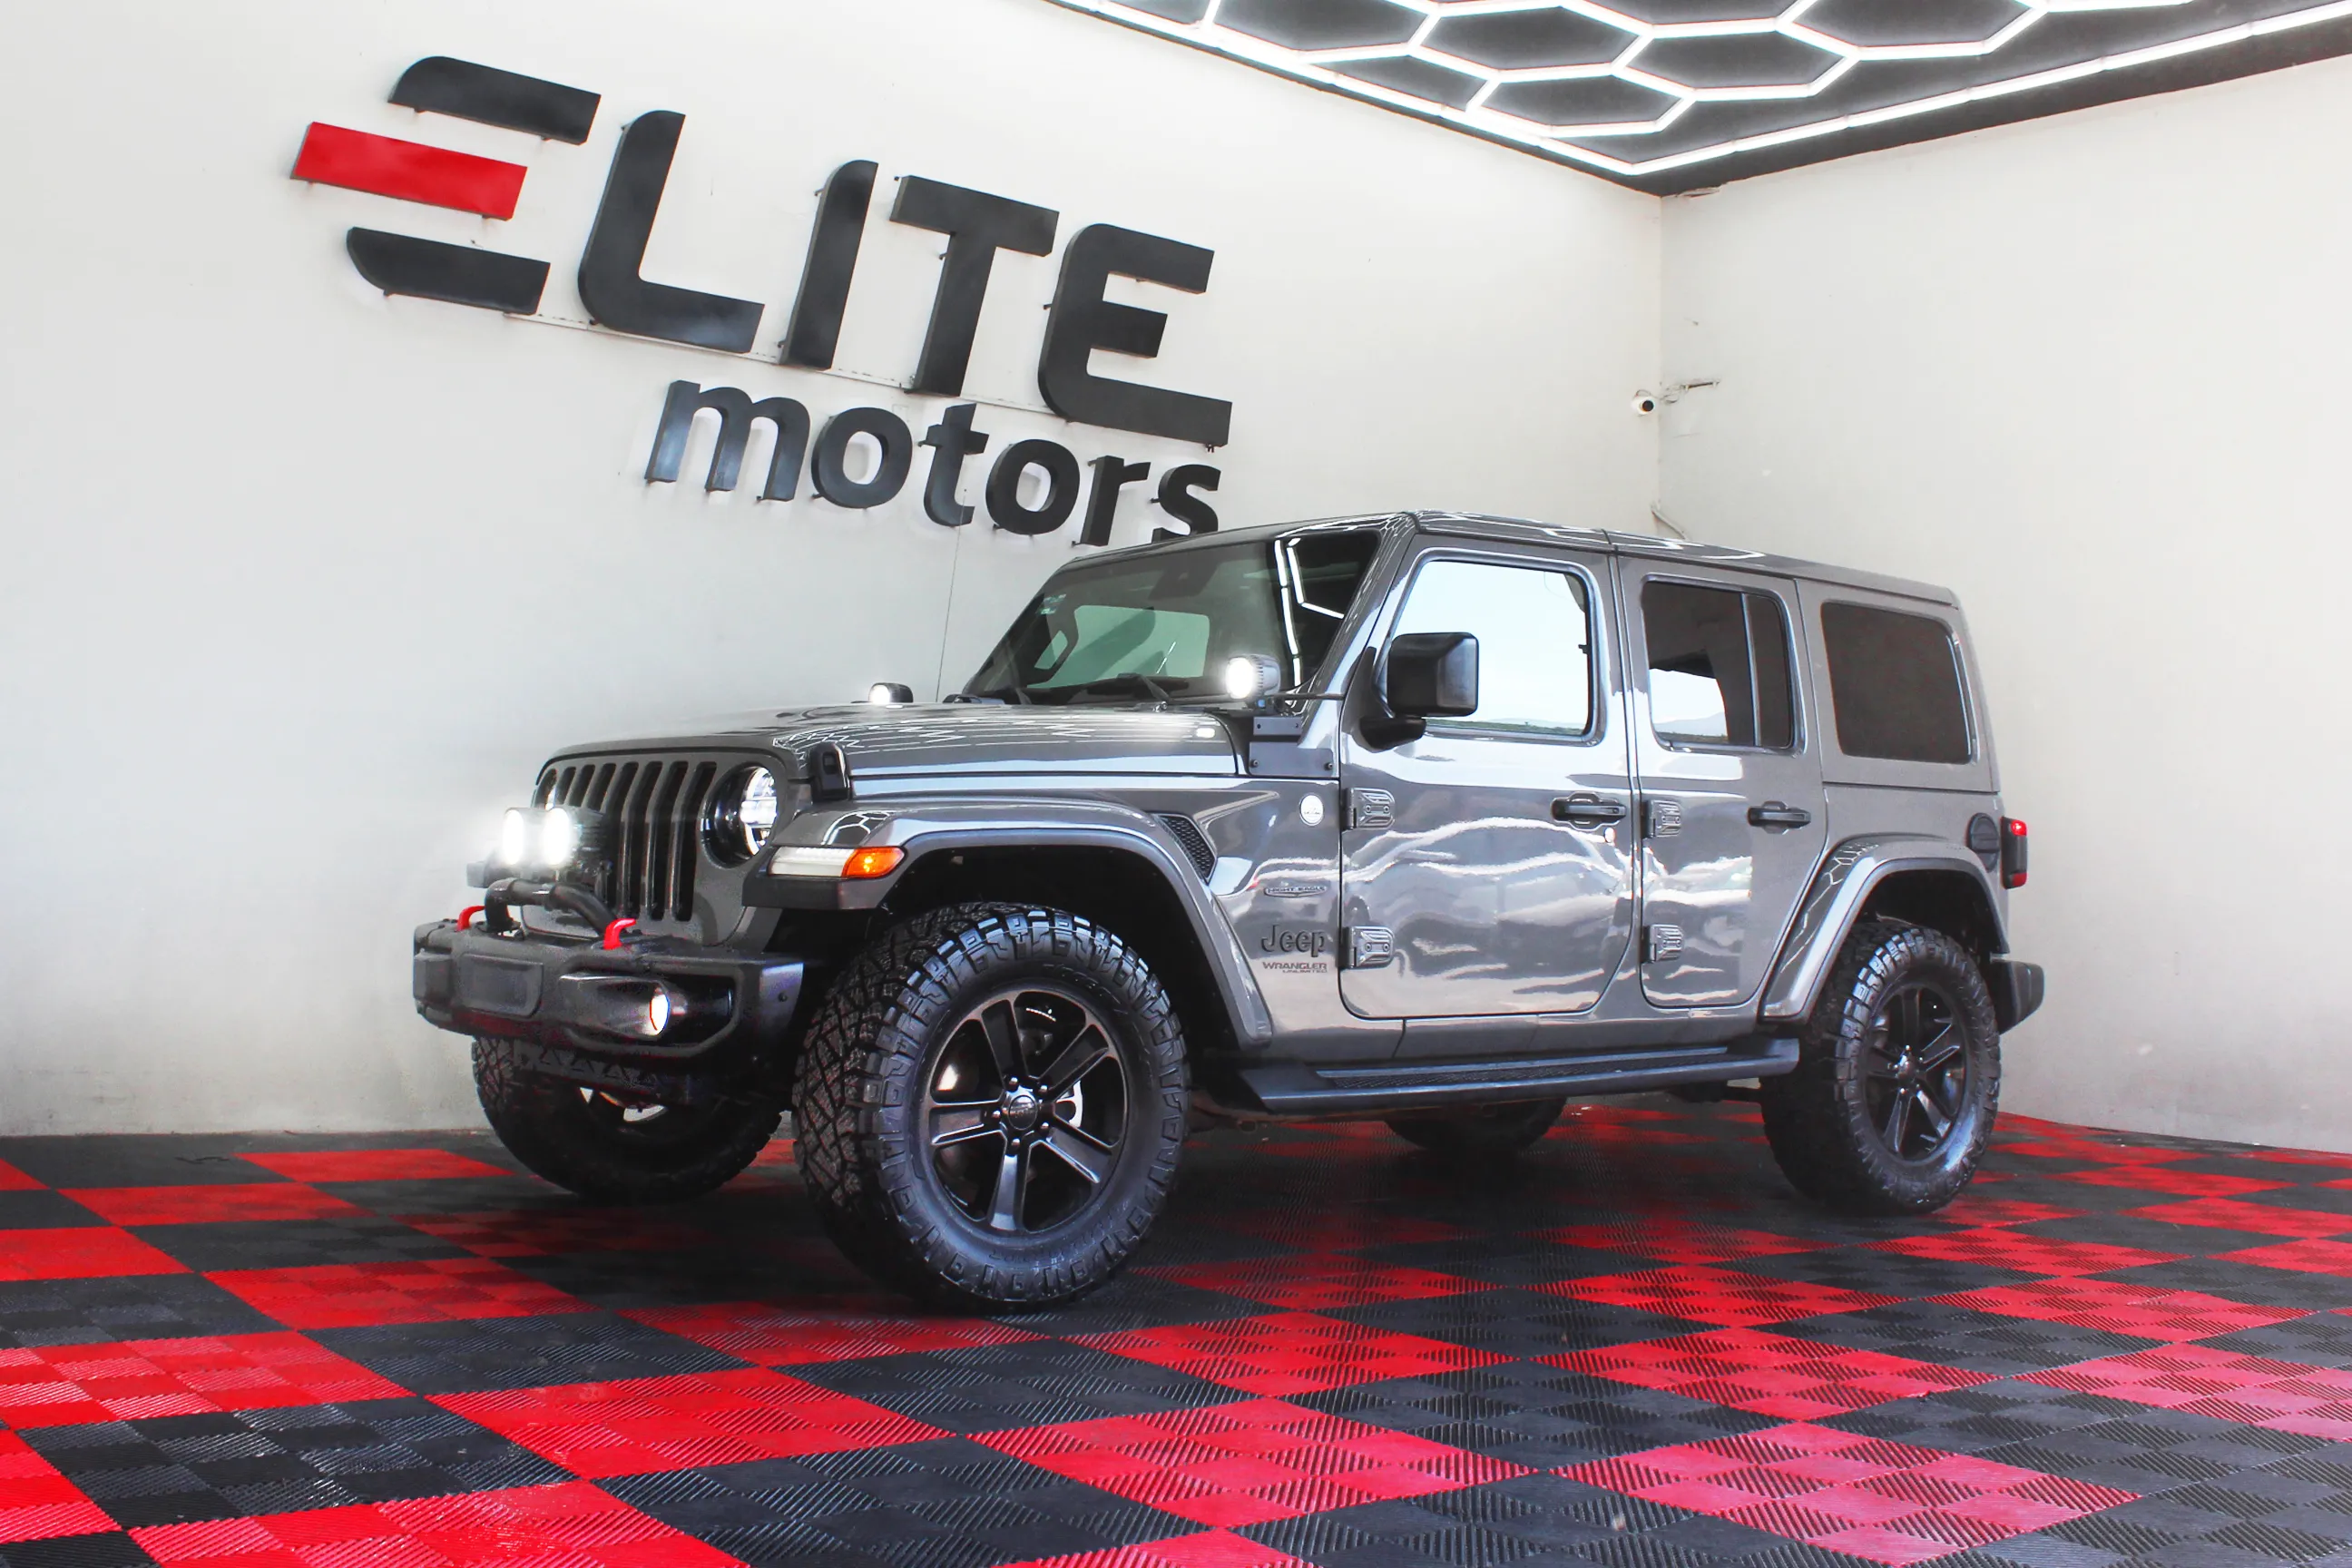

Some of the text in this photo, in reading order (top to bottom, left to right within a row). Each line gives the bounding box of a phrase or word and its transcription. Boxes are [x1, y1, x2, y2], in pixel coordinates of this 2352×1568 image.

[290, 55, 1232, 445] ELITE
[644, 379, 1221, 546] motors
[1261, 924, 1326, 958] Jeep
[1262, 962, 1328, 970] WRANGLER
